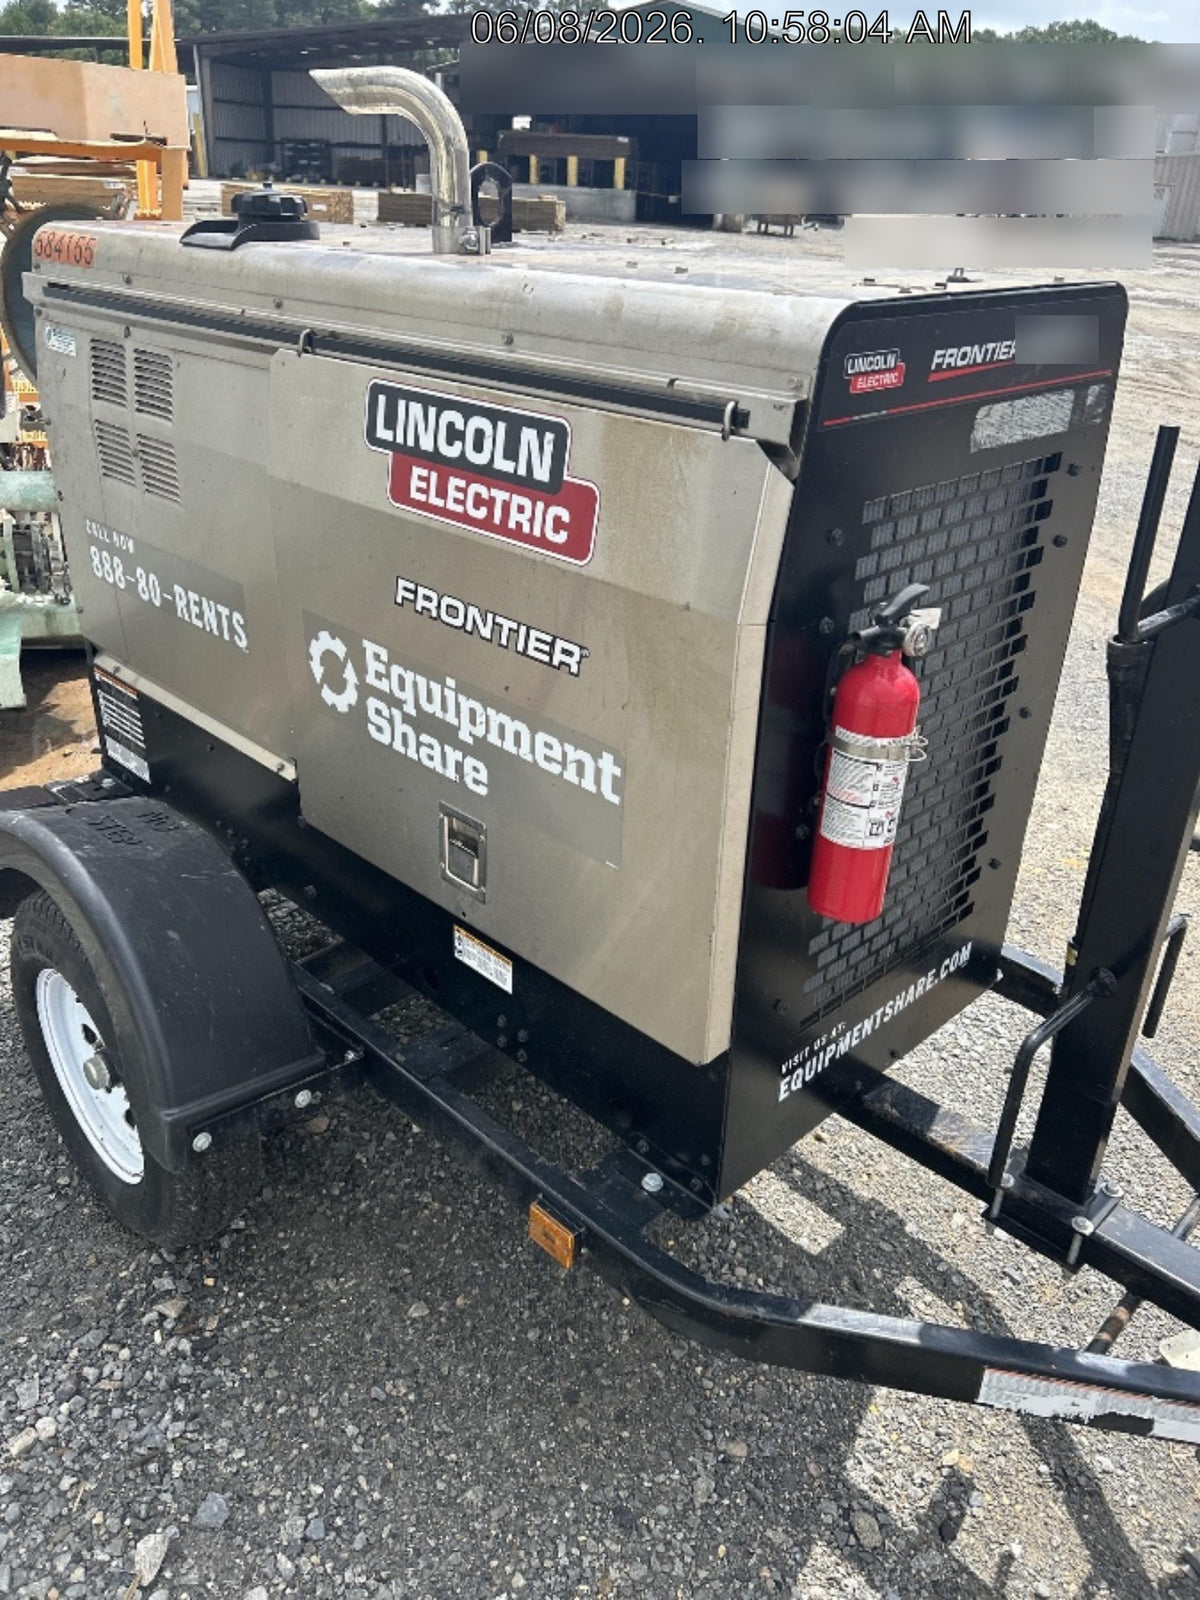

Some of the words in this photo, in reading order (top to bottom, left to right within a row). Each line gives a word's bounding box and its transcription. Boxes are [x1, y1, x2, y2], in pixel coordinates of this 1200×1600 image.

[34, 230, 97, 266] 584155
[846, 352, 899, 374] LINCOLN
[856, 371, 899, 389] ELECTRIC
[375, 394, 555, 483] LINCOLN
[409, 465, 570, 545] ELECTRIC
[89, 545, 248, 649] 888-80-RENTS
[362, 638, 622, 805] Equipment
[366, 696, 488, 797] Share
[778, 942, 974, 1103] EQUIPMENTSHARE.COM
[781, 1046, 810, 1075] VISIT
[814, 1033, 828, 1051] US
